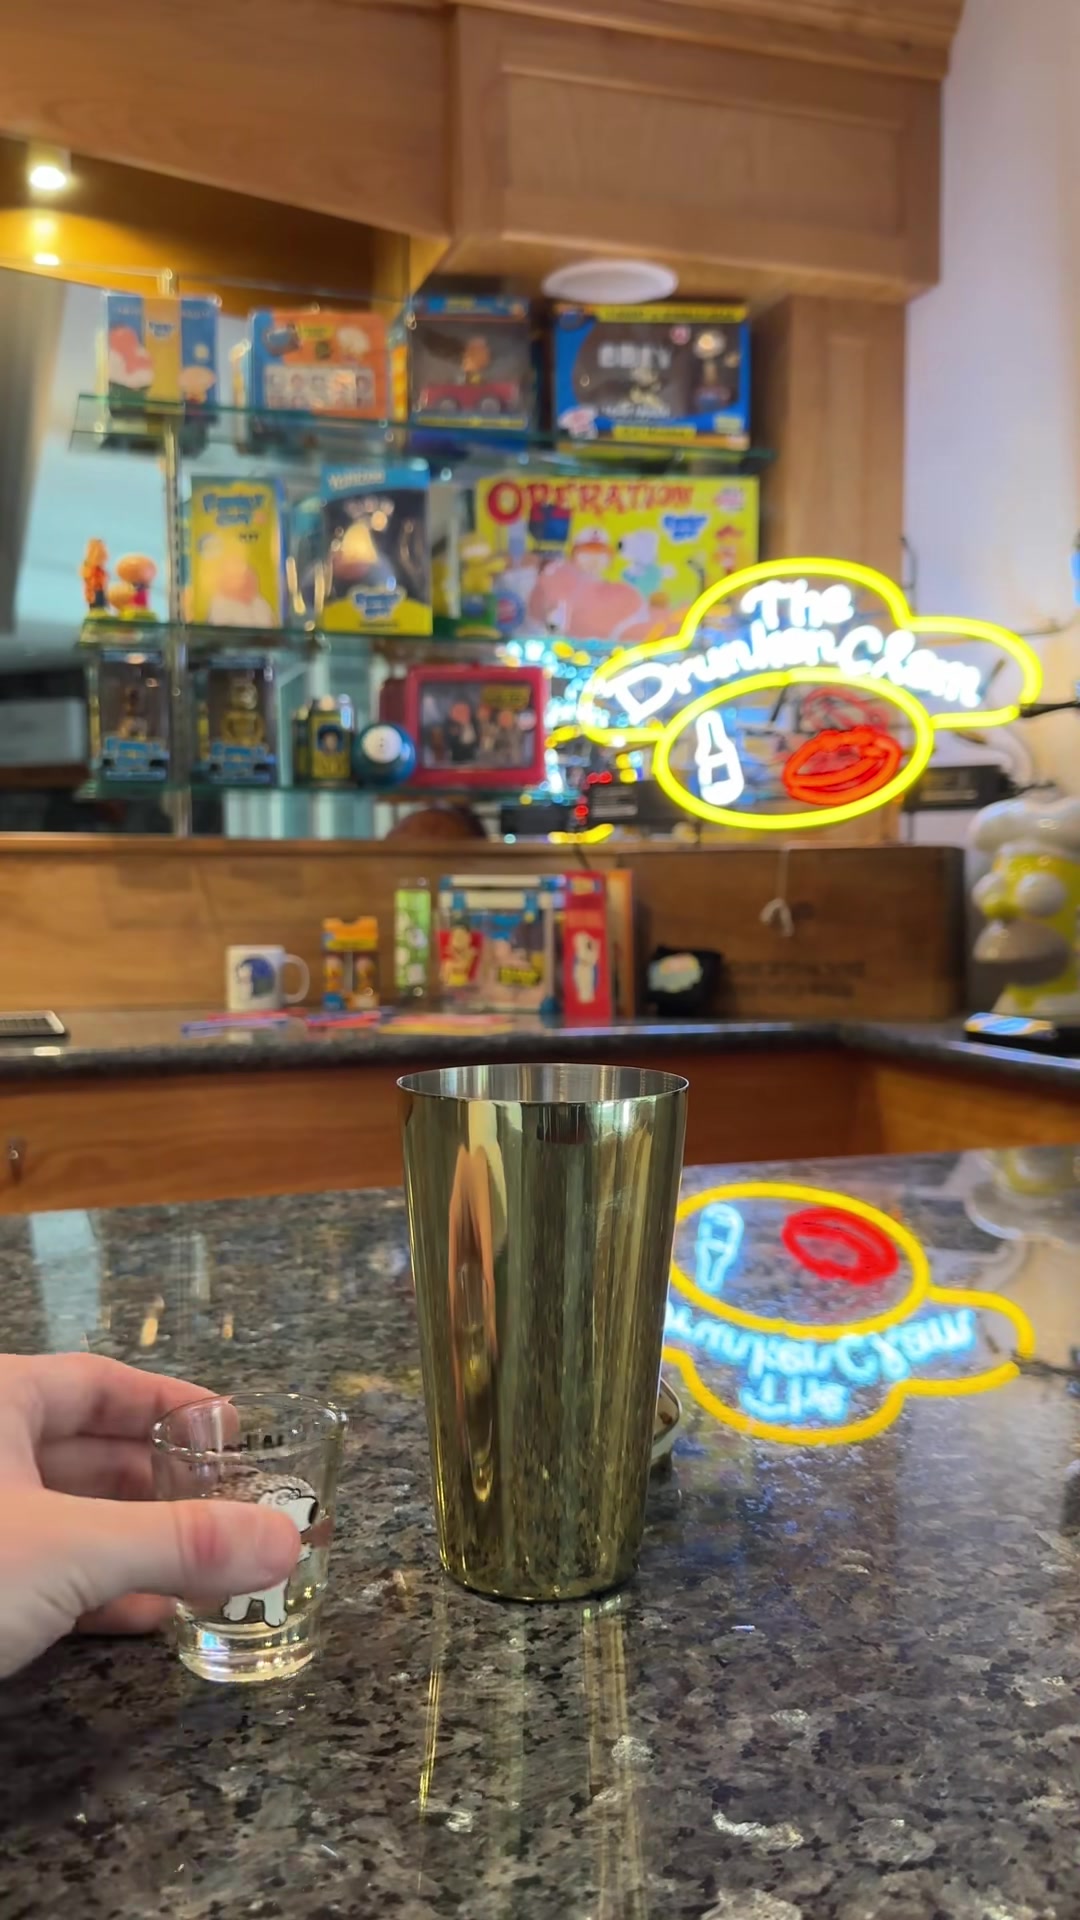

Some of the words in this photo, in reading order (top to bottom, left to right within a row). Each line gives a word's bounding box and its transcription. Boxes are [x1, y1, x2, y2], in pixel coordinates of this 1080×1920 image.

[487, 480, 694, 526] OPERATION
[740, 578, 854, 630] The
[604, 618, 839, 723] Drunken
[836, 625, 982, 708] Clam
